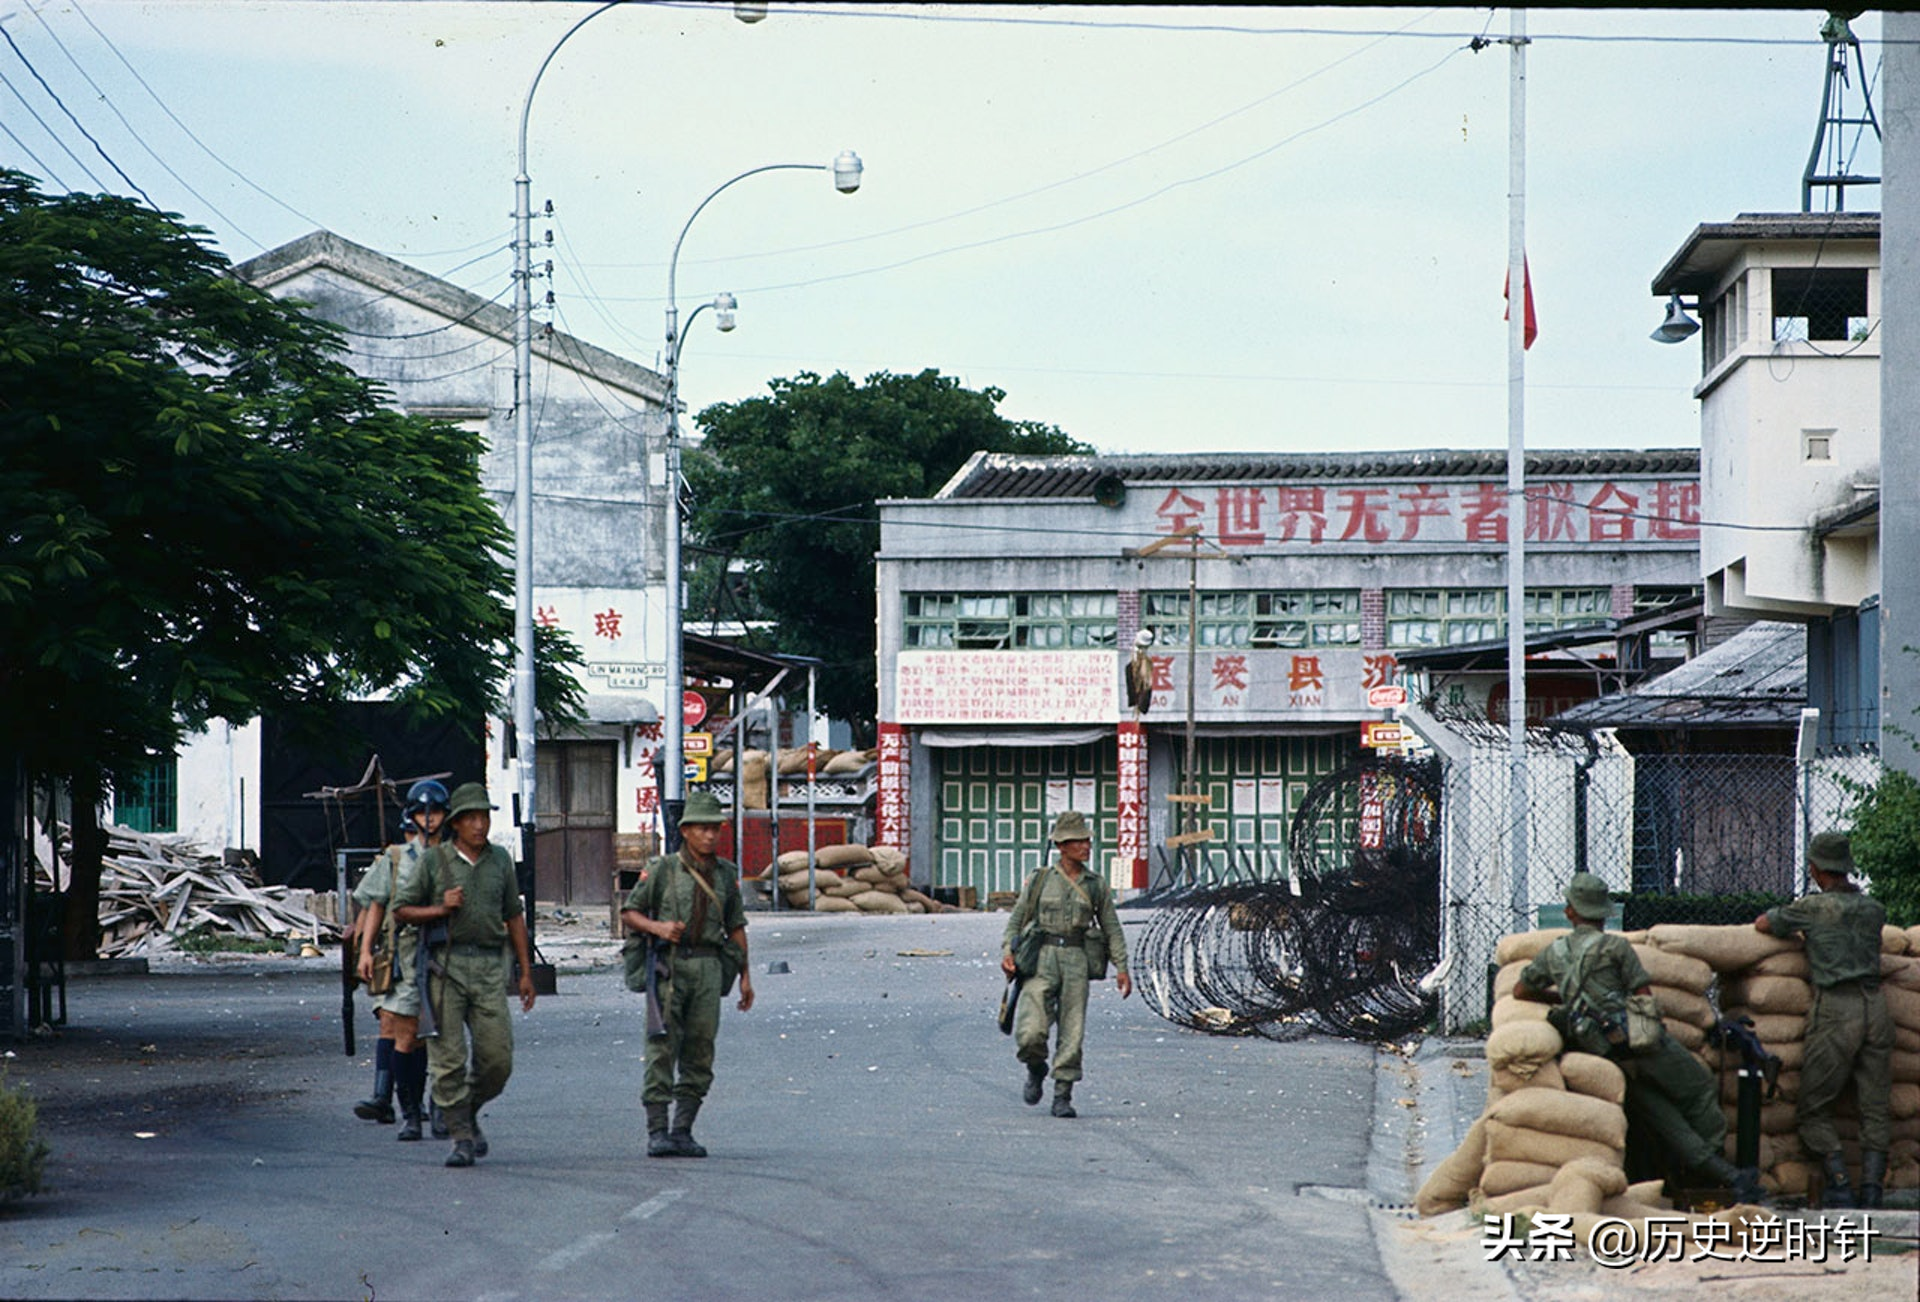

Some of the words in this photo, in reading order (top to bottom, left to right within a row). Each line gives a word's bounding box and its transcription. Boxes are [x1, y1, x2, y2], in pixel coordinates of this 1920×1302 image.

[591, 666, 605, 674] LIN
[625, 666, 648, 674] HANG
[1151, 695, 1168, 707] AO
[1223, 695, 1239, 707] AN
[1289, 695, 1321, 707] XIAN
[880, 733, 900, 848] 无产阶级文化大革
